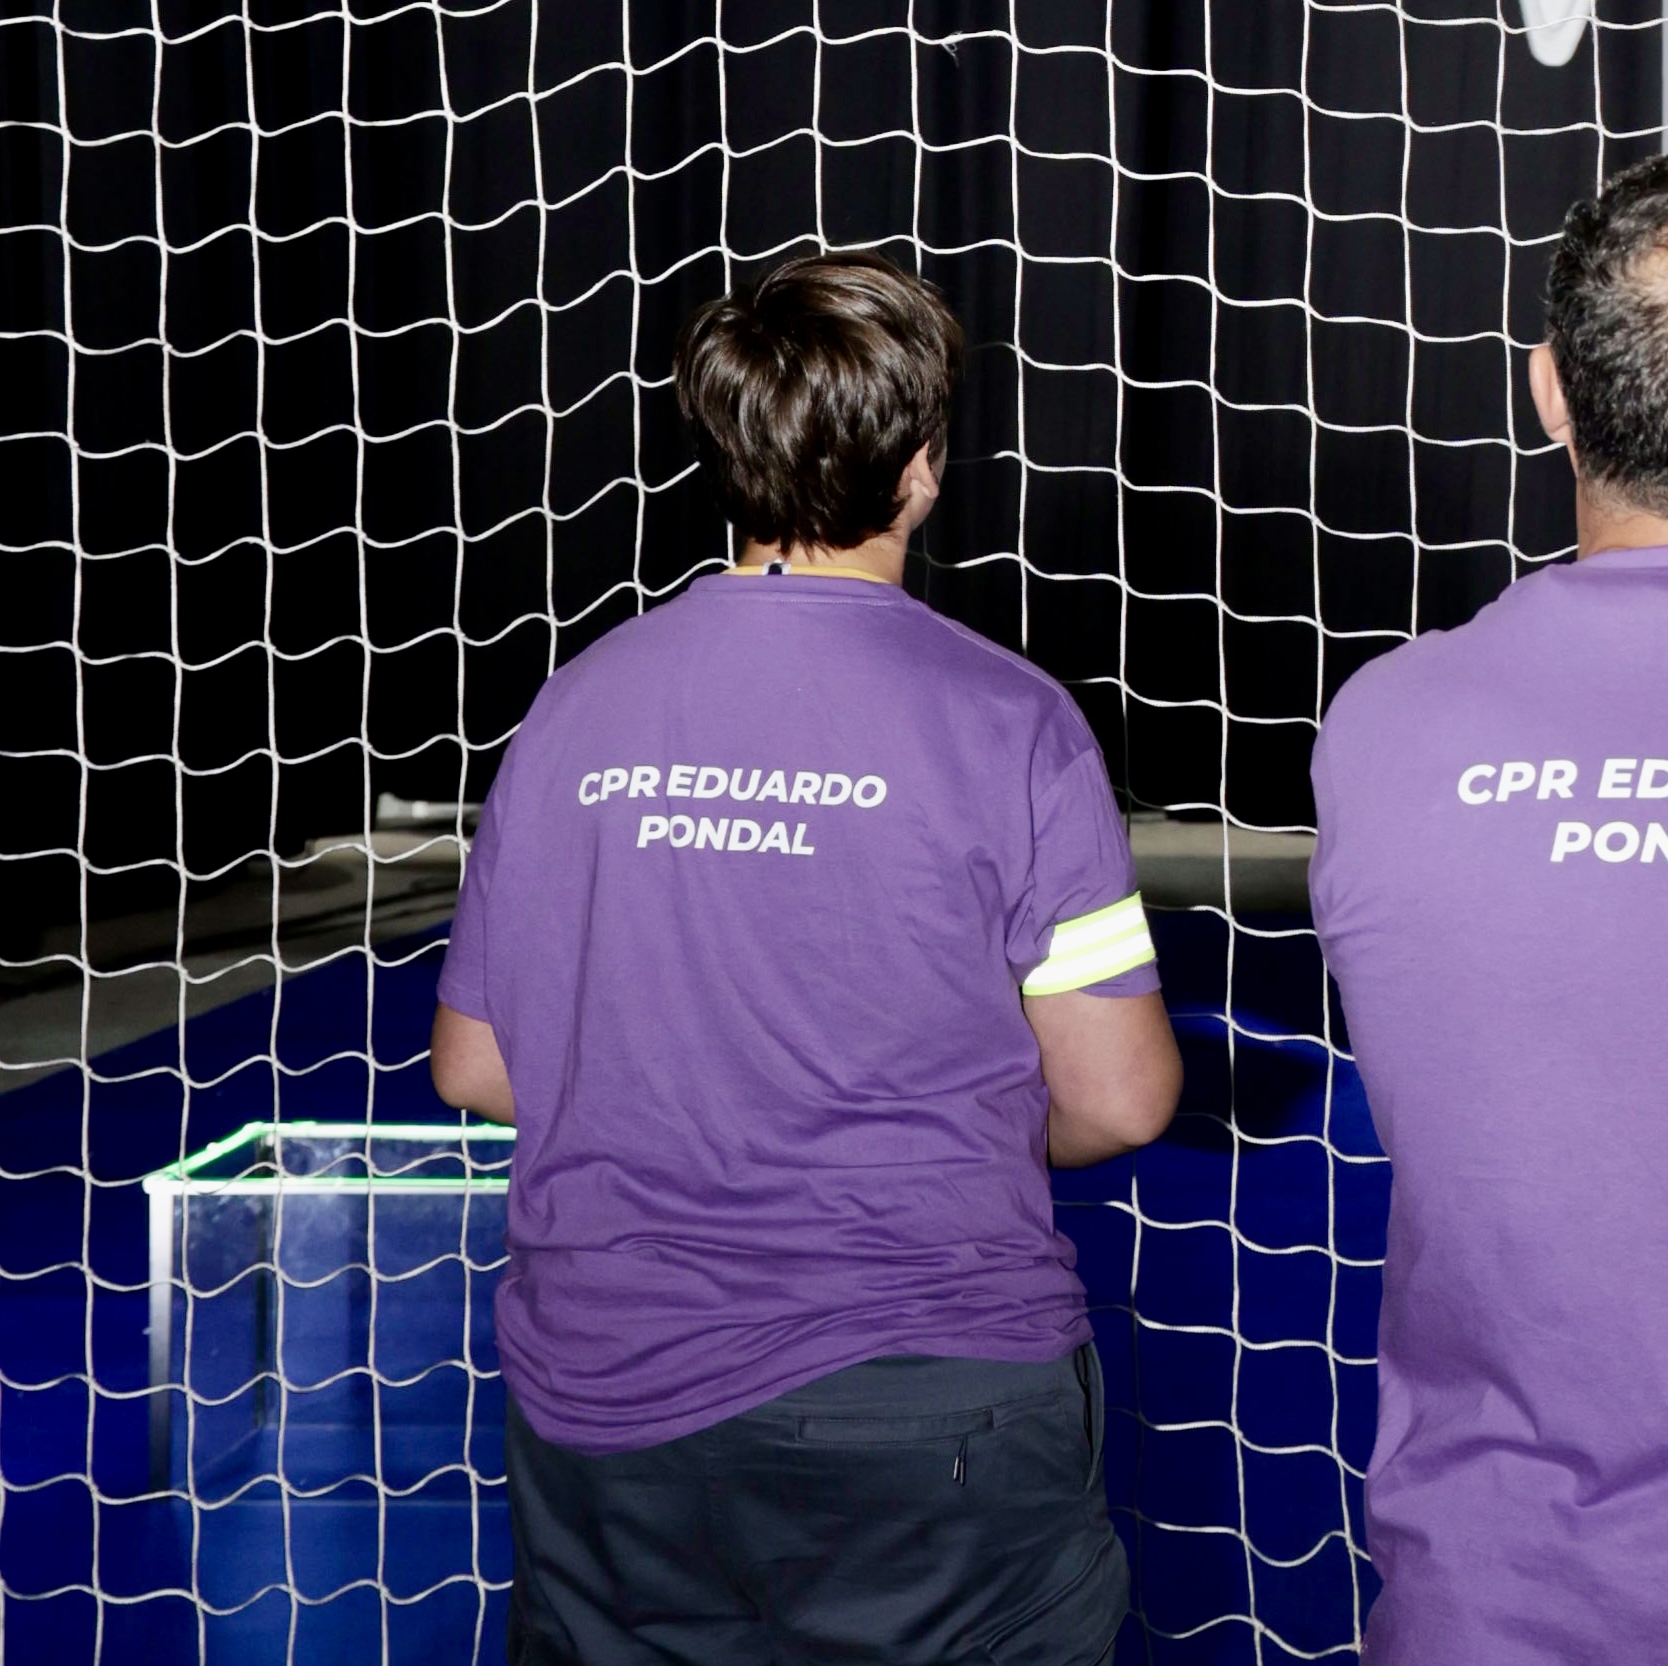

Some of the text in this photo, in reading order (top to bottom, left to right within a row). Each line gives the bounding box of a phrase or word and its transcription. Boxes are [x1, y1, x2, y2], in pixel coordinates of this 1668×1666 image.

[578, 764, 888, 809] CPR EDUARDO
[1456, 759, 1579, 806] CPR
[636, 814, 815, 856] PONDAL
